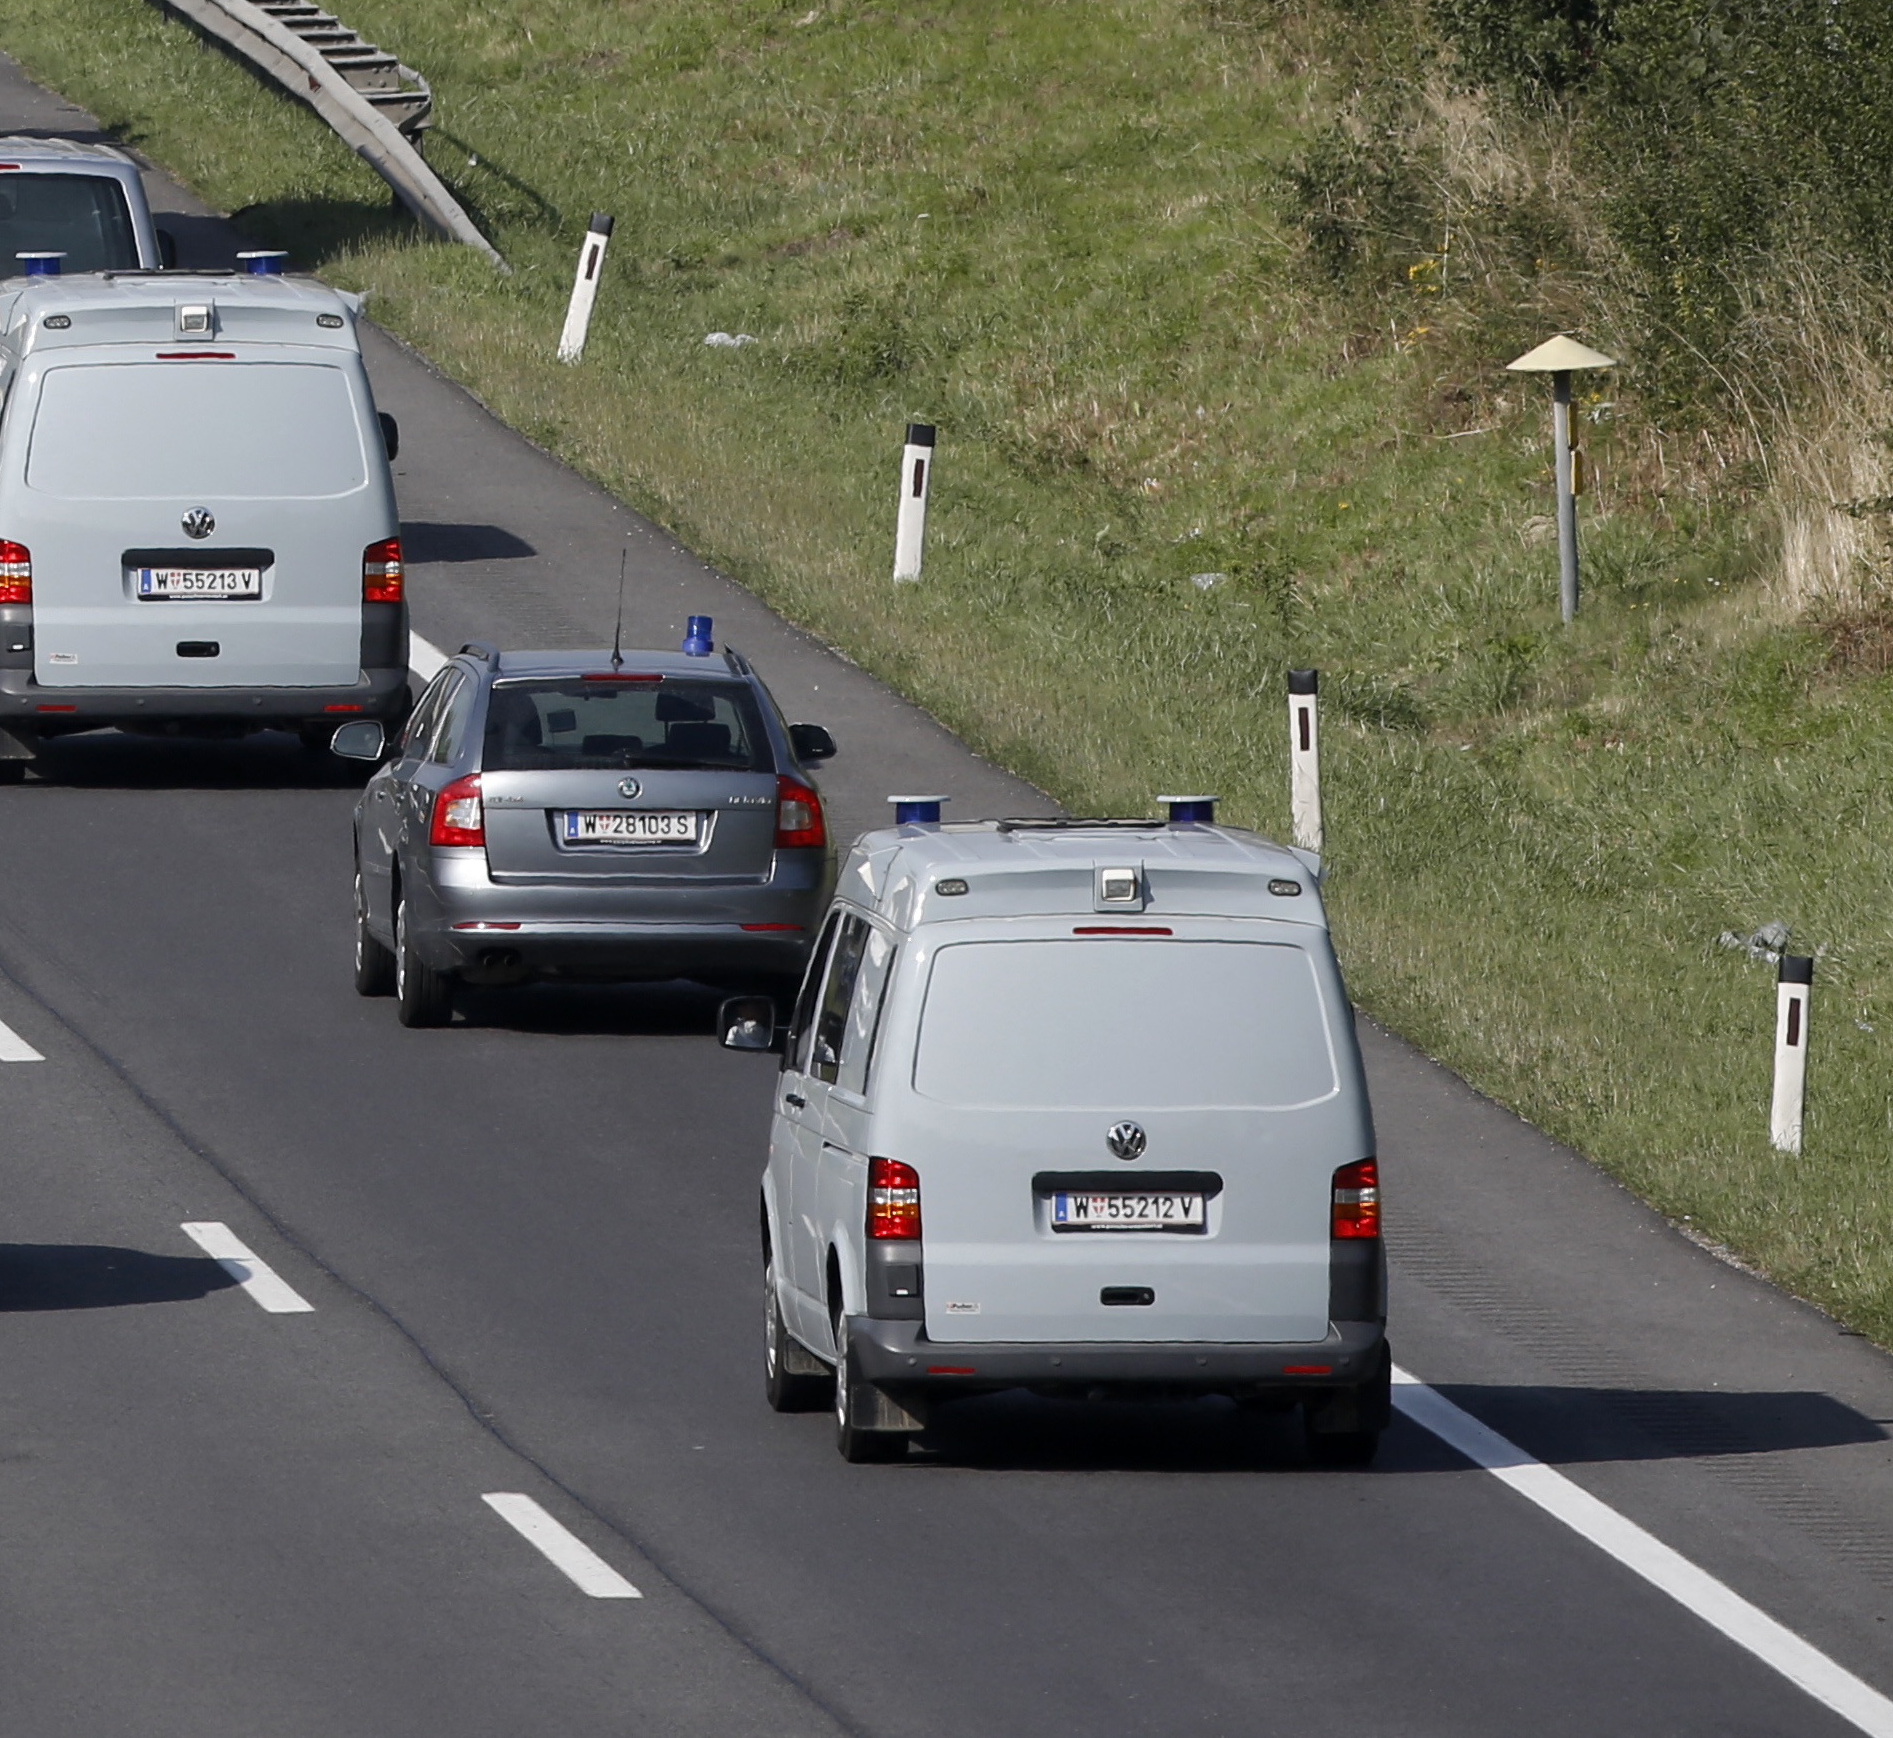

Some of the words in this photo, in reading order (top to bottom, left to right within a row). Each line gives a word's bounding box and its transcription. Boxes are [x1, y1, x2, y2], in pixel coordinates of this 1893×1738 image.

[156, 572, 168, 590] W
[183, 572, 237, 590] 55213
[242, 572, 252, 590] V
[585, 814, 596, 833] W
[613, 812, 670, 834] 28103
[677, 811, 687, 833] S
[1074, 1196, 1089, 1219] W
[1107, 1196, 1174, 1219] 55212
[1180, 1196, 1193, 1219] V
